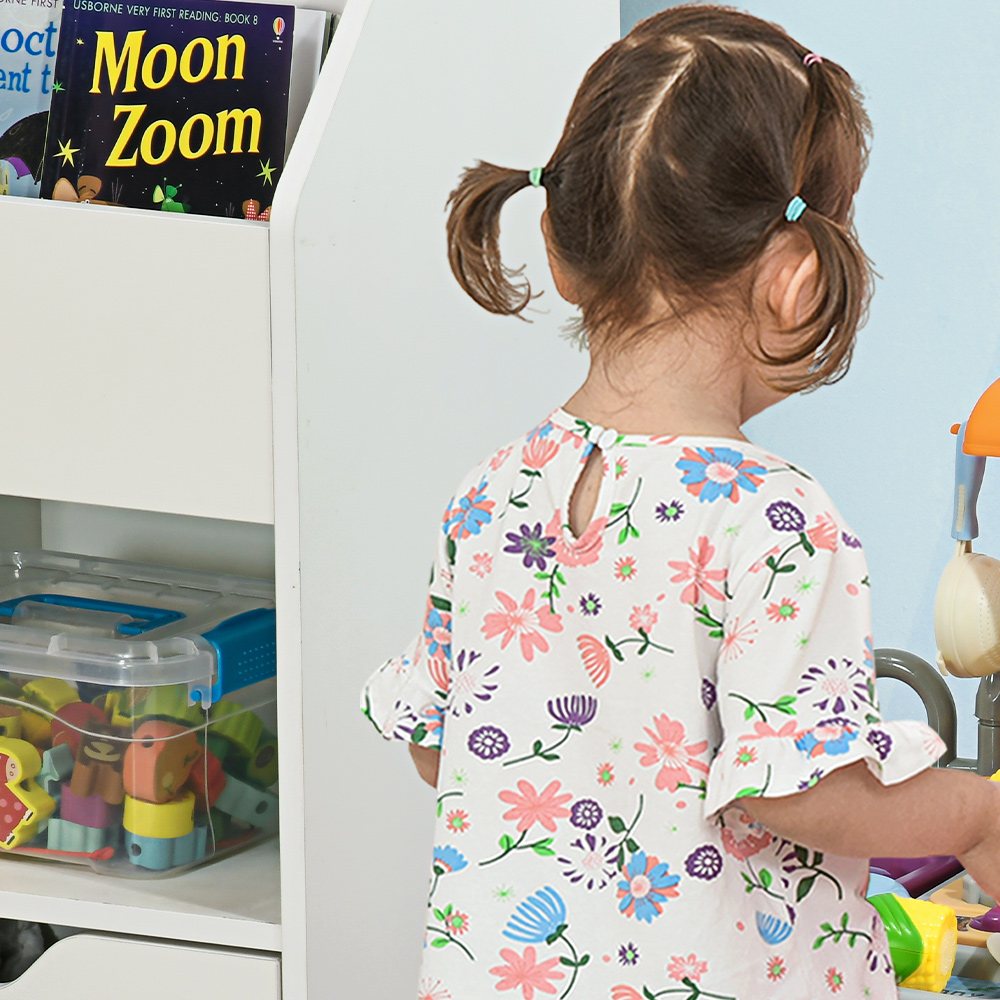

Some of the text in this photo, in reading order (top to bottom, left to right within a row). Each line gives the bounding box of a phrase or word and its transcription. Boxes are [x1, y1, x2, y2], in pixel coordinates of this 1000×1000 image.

[73, 0, 259, 26] USBORNE VERY FIRST READING: BOOK 8
[89, 29, 246, 95] Moon
[105, 104, 262, 167] Zoom
